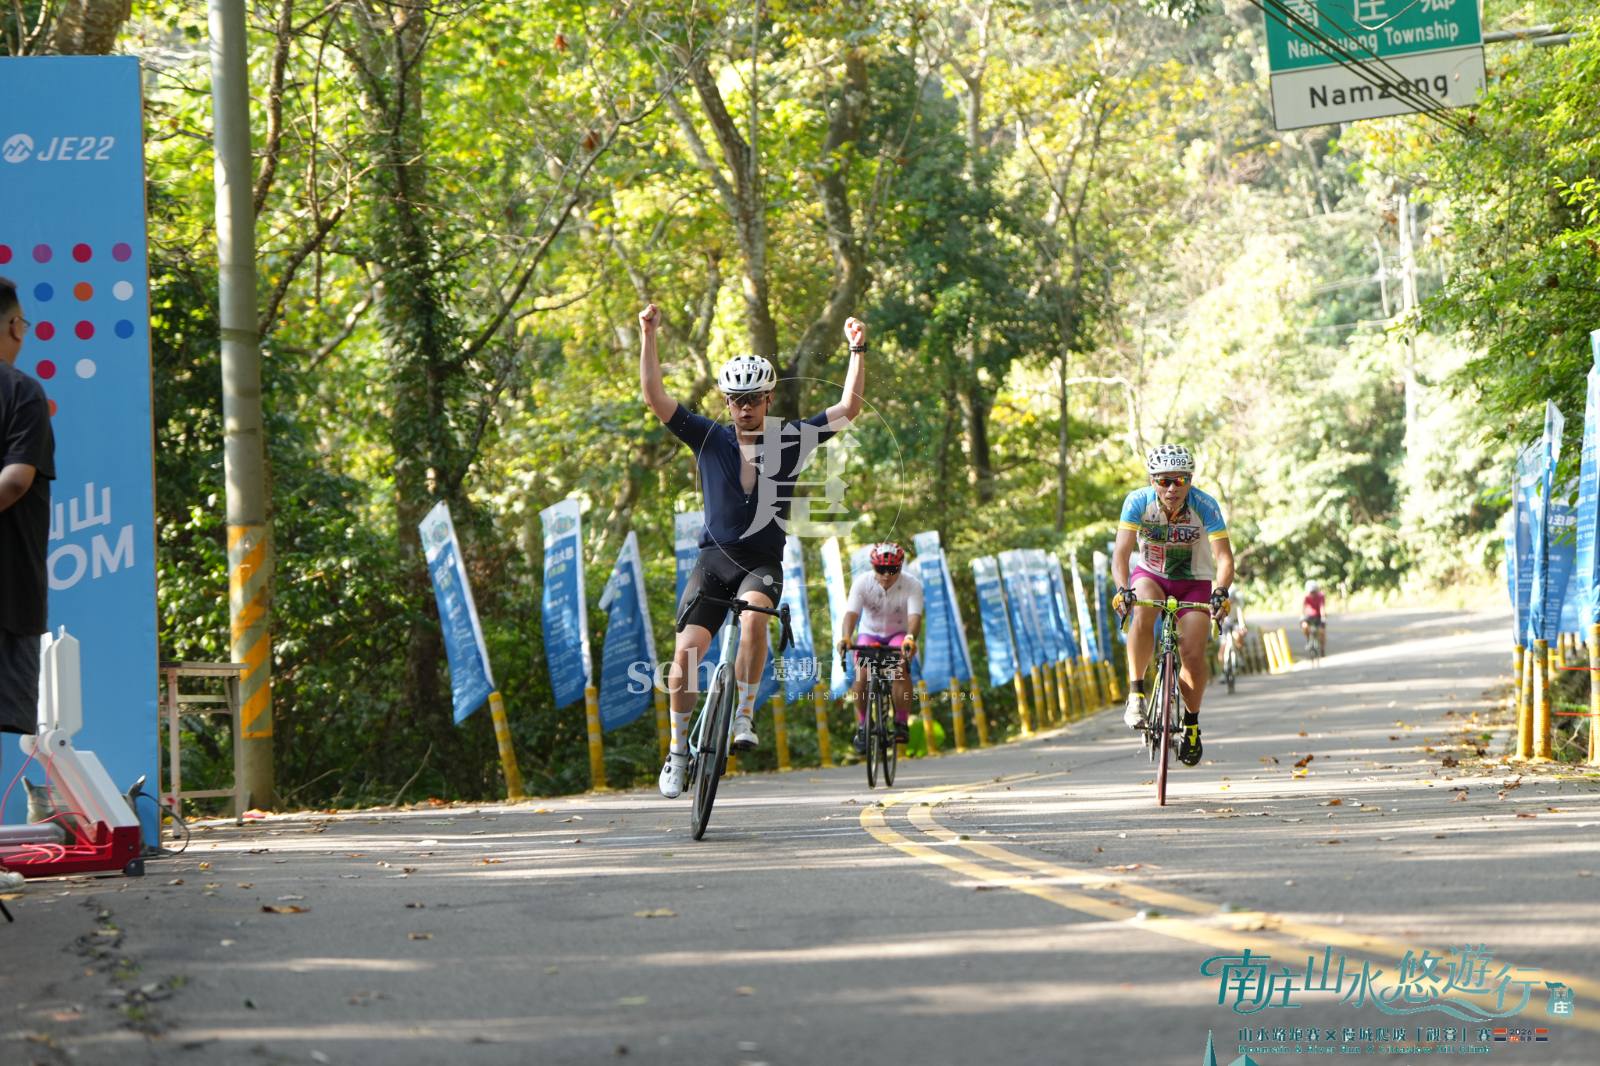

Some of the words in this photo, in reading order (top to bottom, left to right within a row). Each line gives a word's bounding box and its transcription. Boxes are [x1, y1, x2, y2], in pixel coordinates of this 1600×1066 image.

[1384, 20, 1459, 46] Township
[1309, 74, 1448, 109] Namzong
[37, 136, 115, 162] JE22
